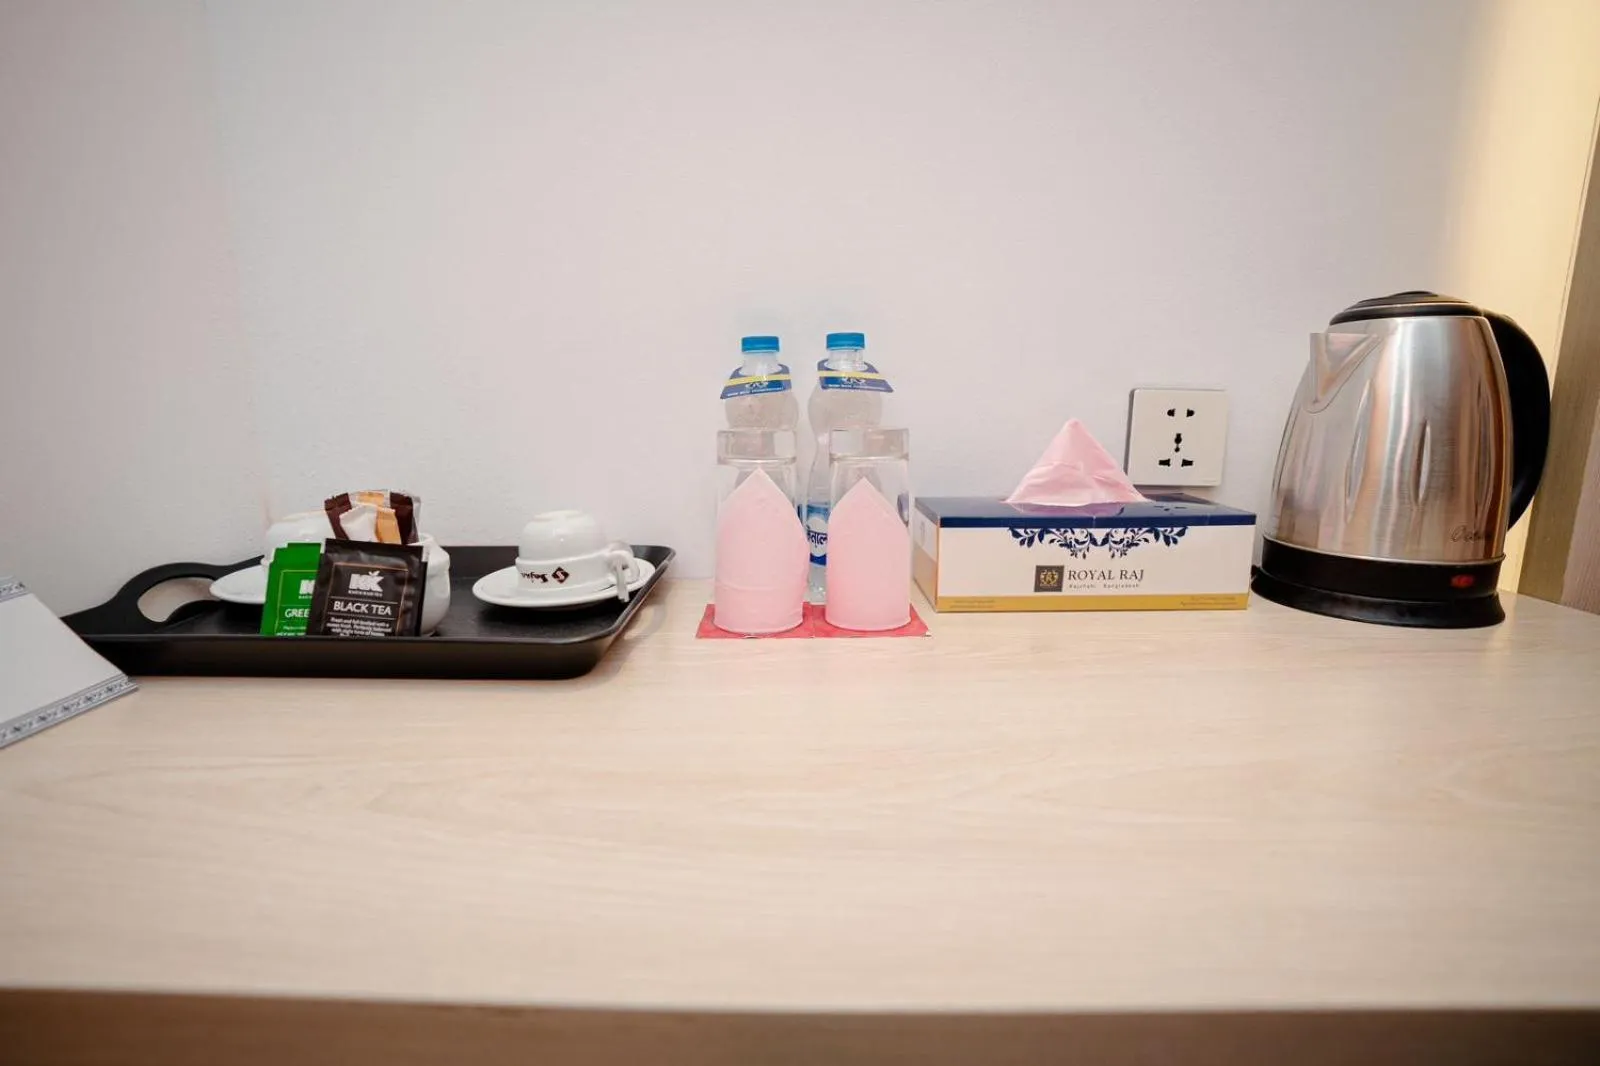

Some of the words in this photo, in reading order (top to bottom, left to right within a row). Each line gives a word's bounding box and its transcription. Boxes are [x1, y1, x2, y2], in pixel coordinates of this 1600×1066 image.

[1068, 569, 1115, 581] ROYAL
[1119, 569, 1145, 582] RAJ
[284, 608, 310, 618] GREE
[333, 600, 369, 614] BLACK
[372, 603, 393, 616] TEA
